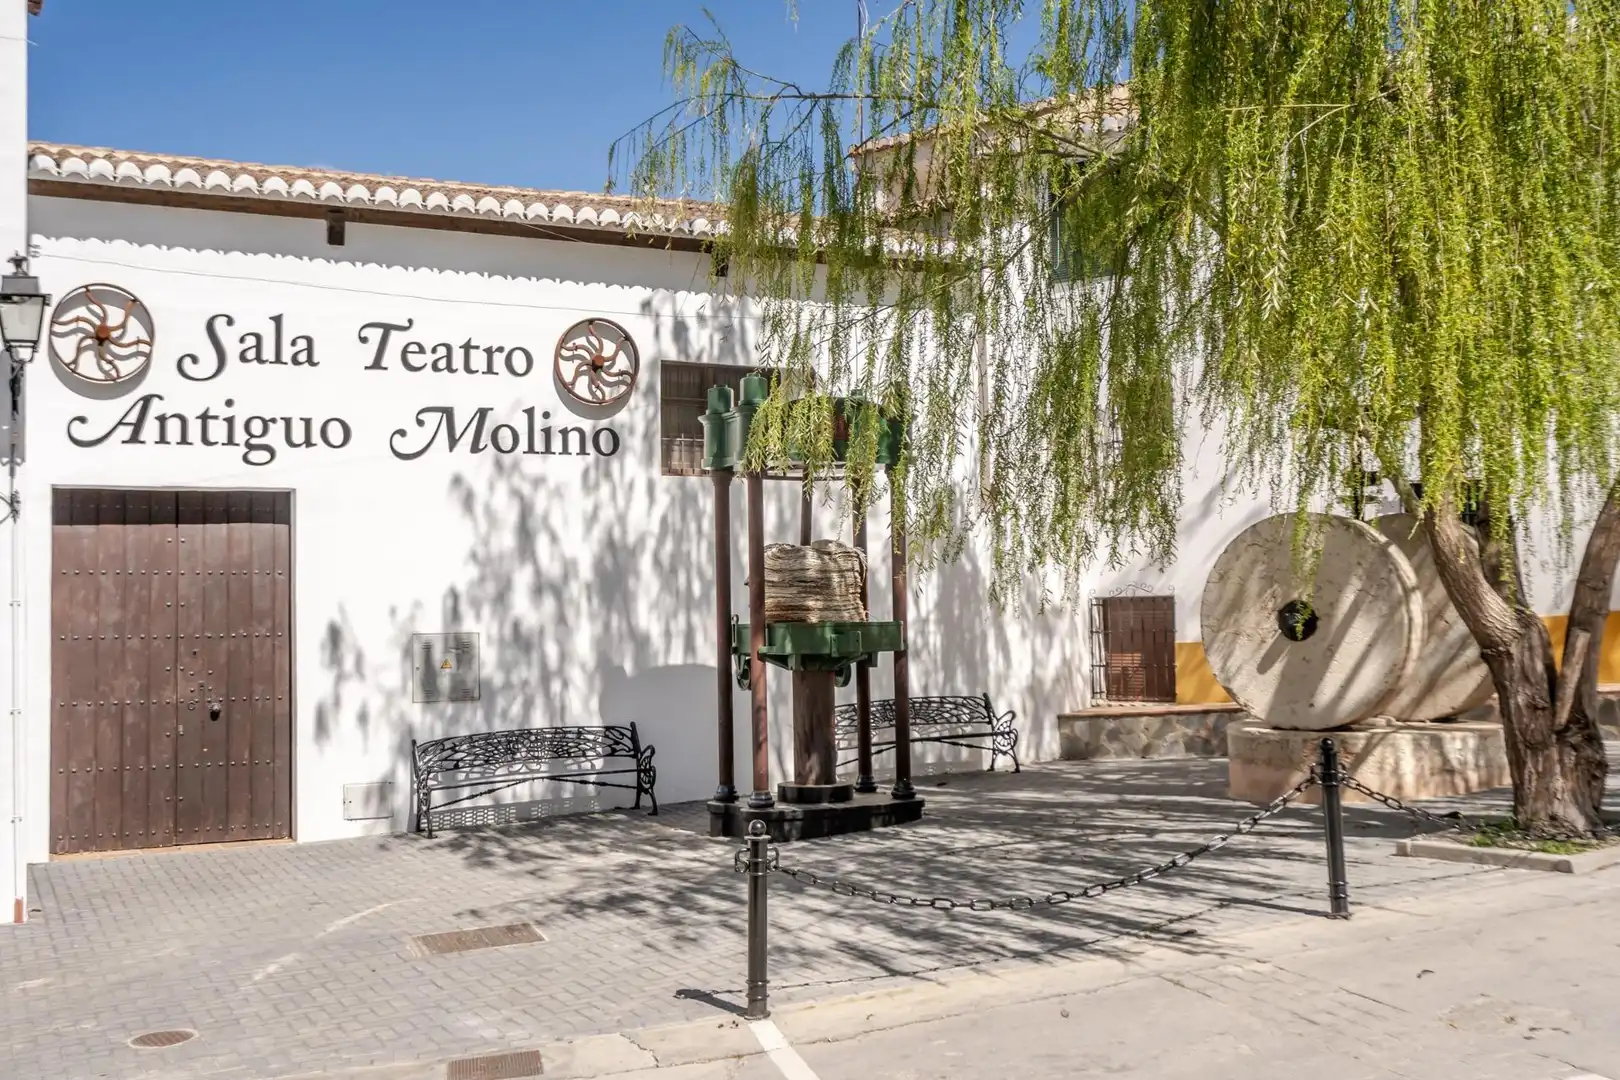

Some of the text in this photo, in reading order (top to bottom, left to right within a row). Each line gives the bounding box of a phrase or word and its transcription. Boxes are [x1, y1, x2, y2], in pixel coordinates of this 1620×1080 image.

[177, 313, 534, 382] Sala Teatro
[67, 393, 621, 466] Antiguo Molino
